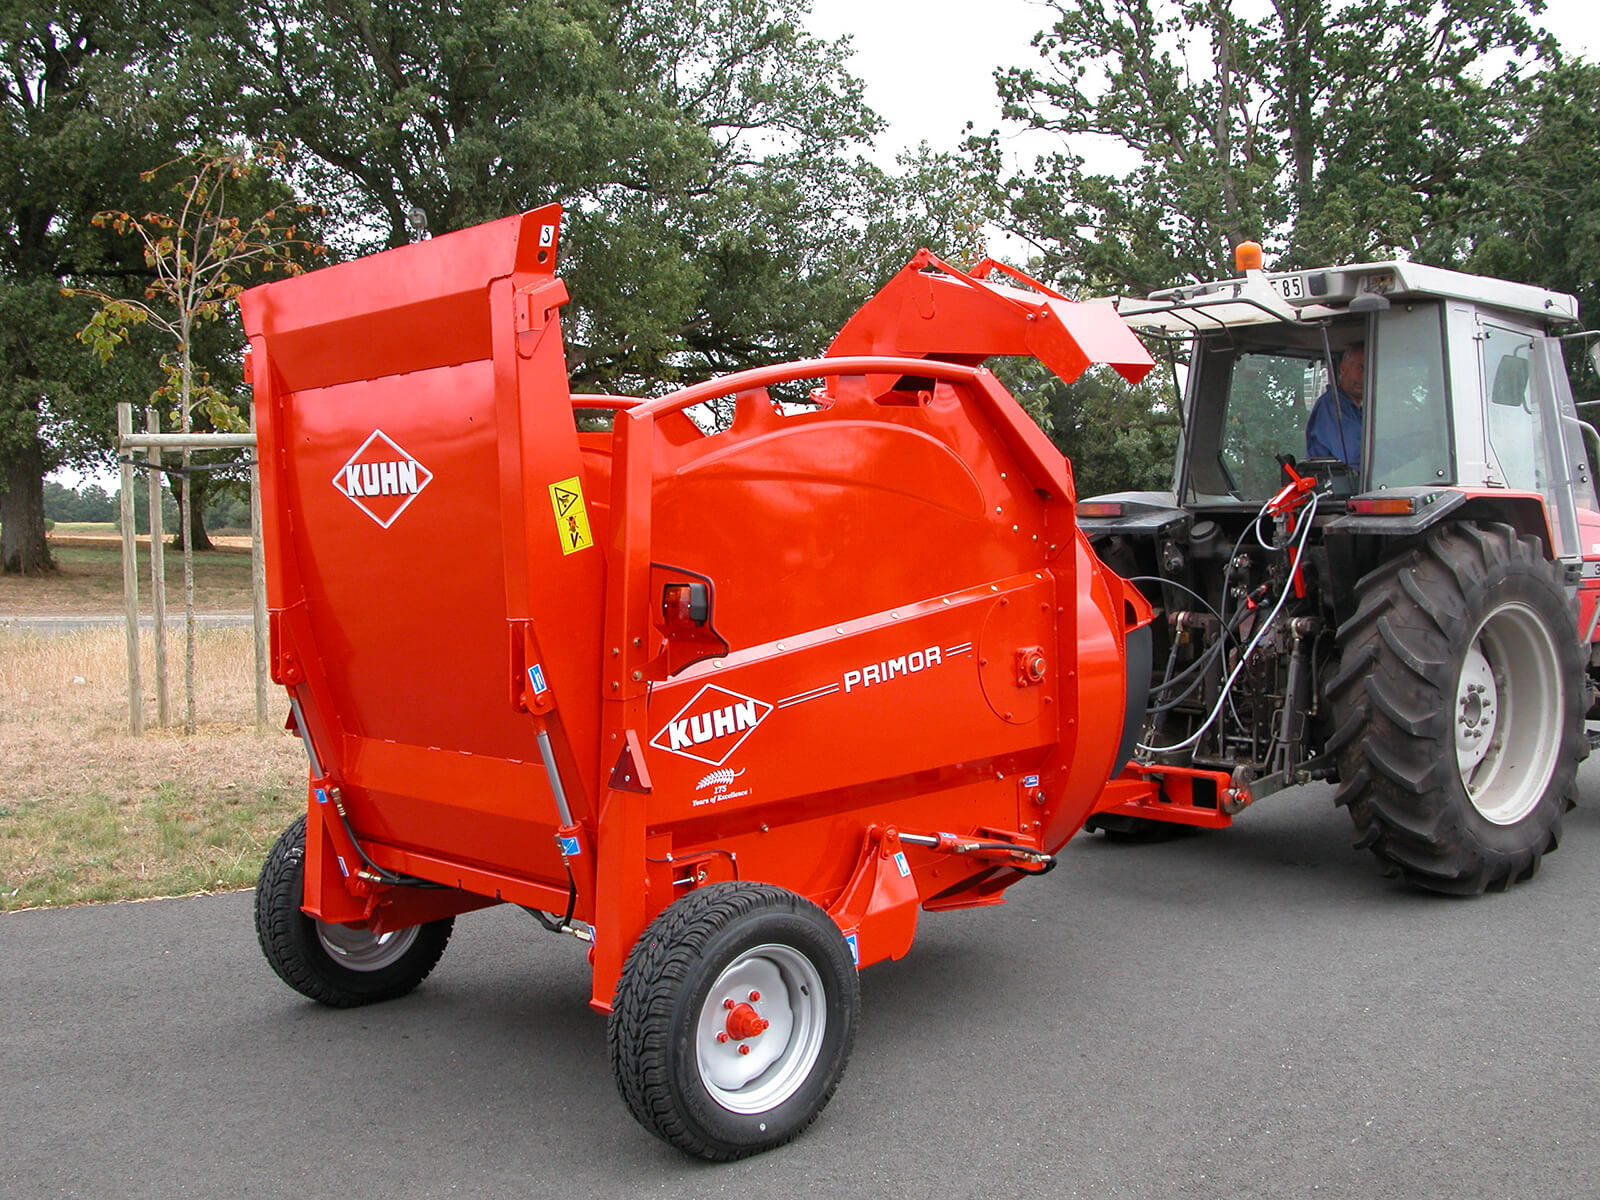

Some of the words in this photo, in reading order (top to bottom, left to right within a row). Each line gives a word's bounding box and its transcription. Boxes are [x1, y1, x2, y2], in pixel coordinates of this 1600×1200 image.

[1282, 278, 1301, 297] 85
[346, 460, 418, 497] KUHN
[843, 645, 942, 693] PRIMOR
[668, 699, 758, 751] KUHN
